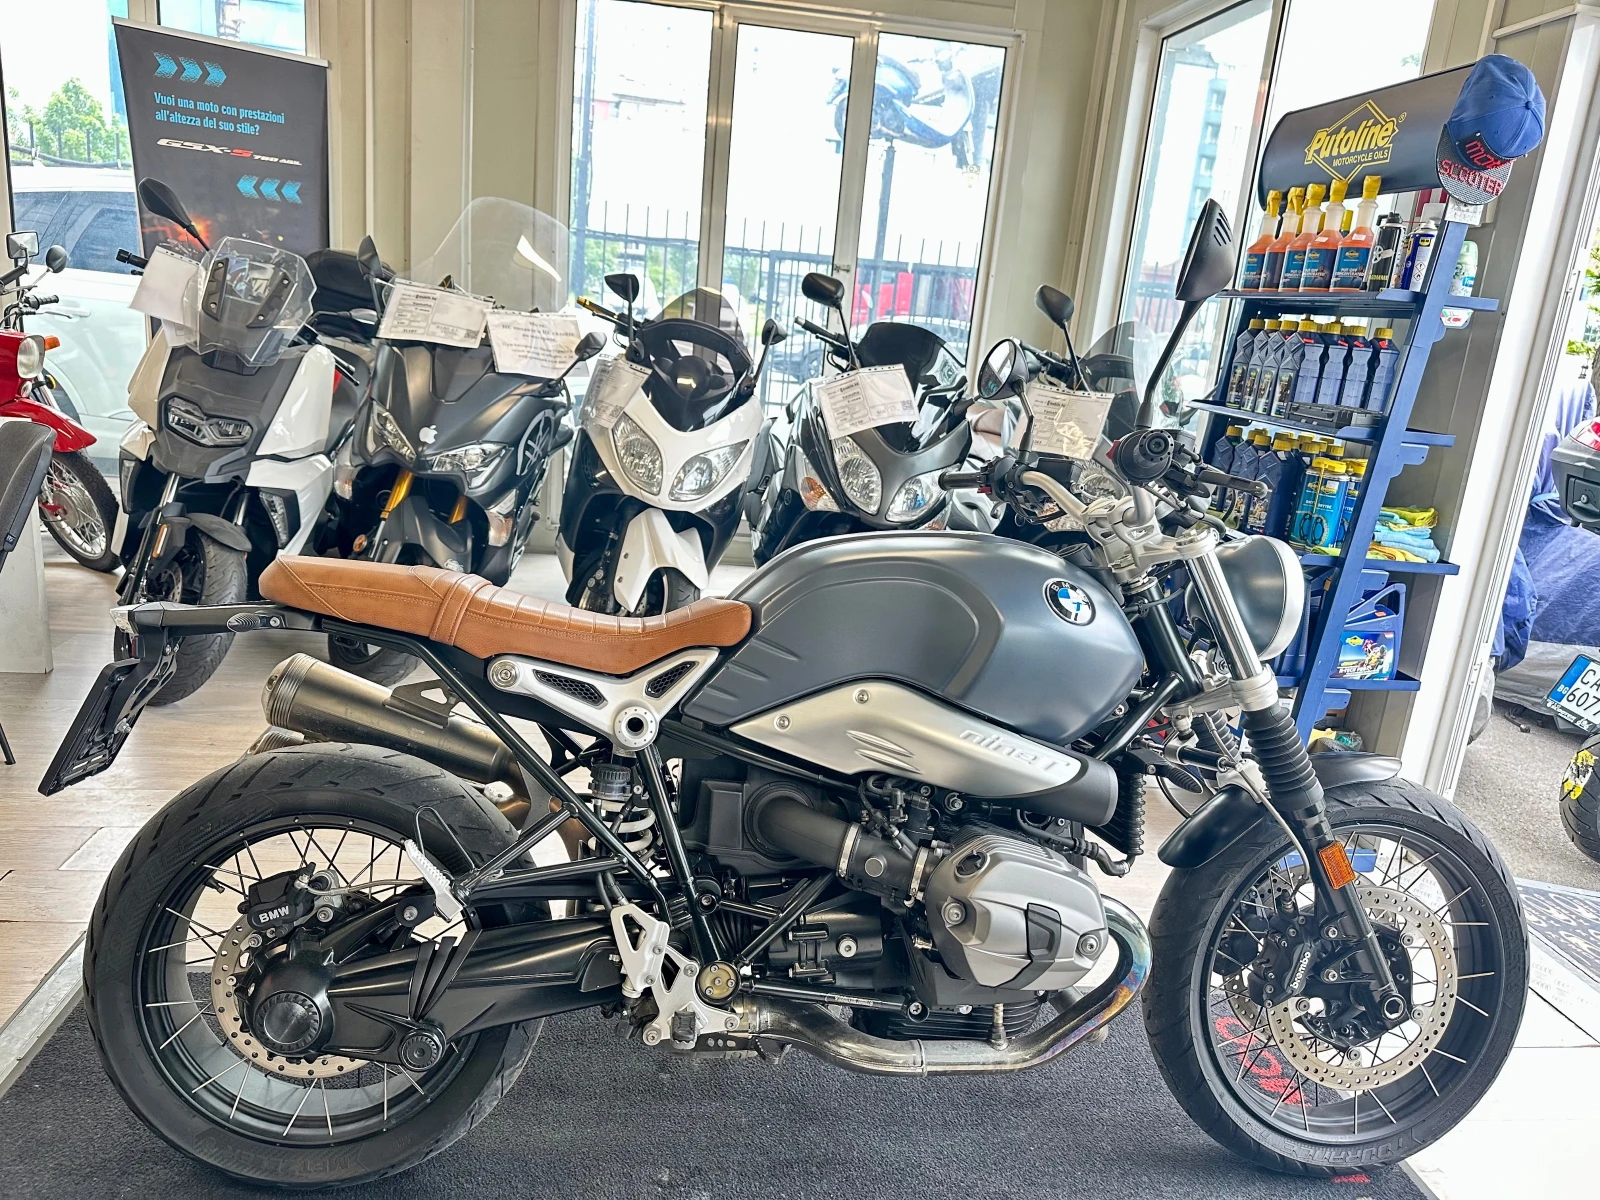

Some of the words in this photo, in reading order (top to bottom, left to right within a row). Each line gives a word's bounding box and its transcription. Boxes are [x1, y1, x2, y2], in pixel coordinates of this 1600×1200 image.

[154, 92, 175, 106] Vuoi
[177, 97, 194, 109] una
[196, 101, 219, 113] moto
[221, 105, 237, 116] con
[239, 108, 285, 124] prestazioni
[155, 110, 201, 126] all'altezza
[203, 117, 217, 129] del
[218, 121, 234, 132] suo
[236, 123, 260, 135] stile?
[157, 138, 254, 158] GSX-S
[1307, 119, 1394, 160] Putoline
[1333, 152, 1373, 167] MOTORCYCLE
[1373, 150, 1388, 161] OILS
[1440, 159, 1504, 196] SCOOTER
[1557, 684, 1570, 695] BG
[1566, 687, 1600, 716] 607
[258, 905, 290, 924] BMW
[1290, 951, 1311, 990] brembo
